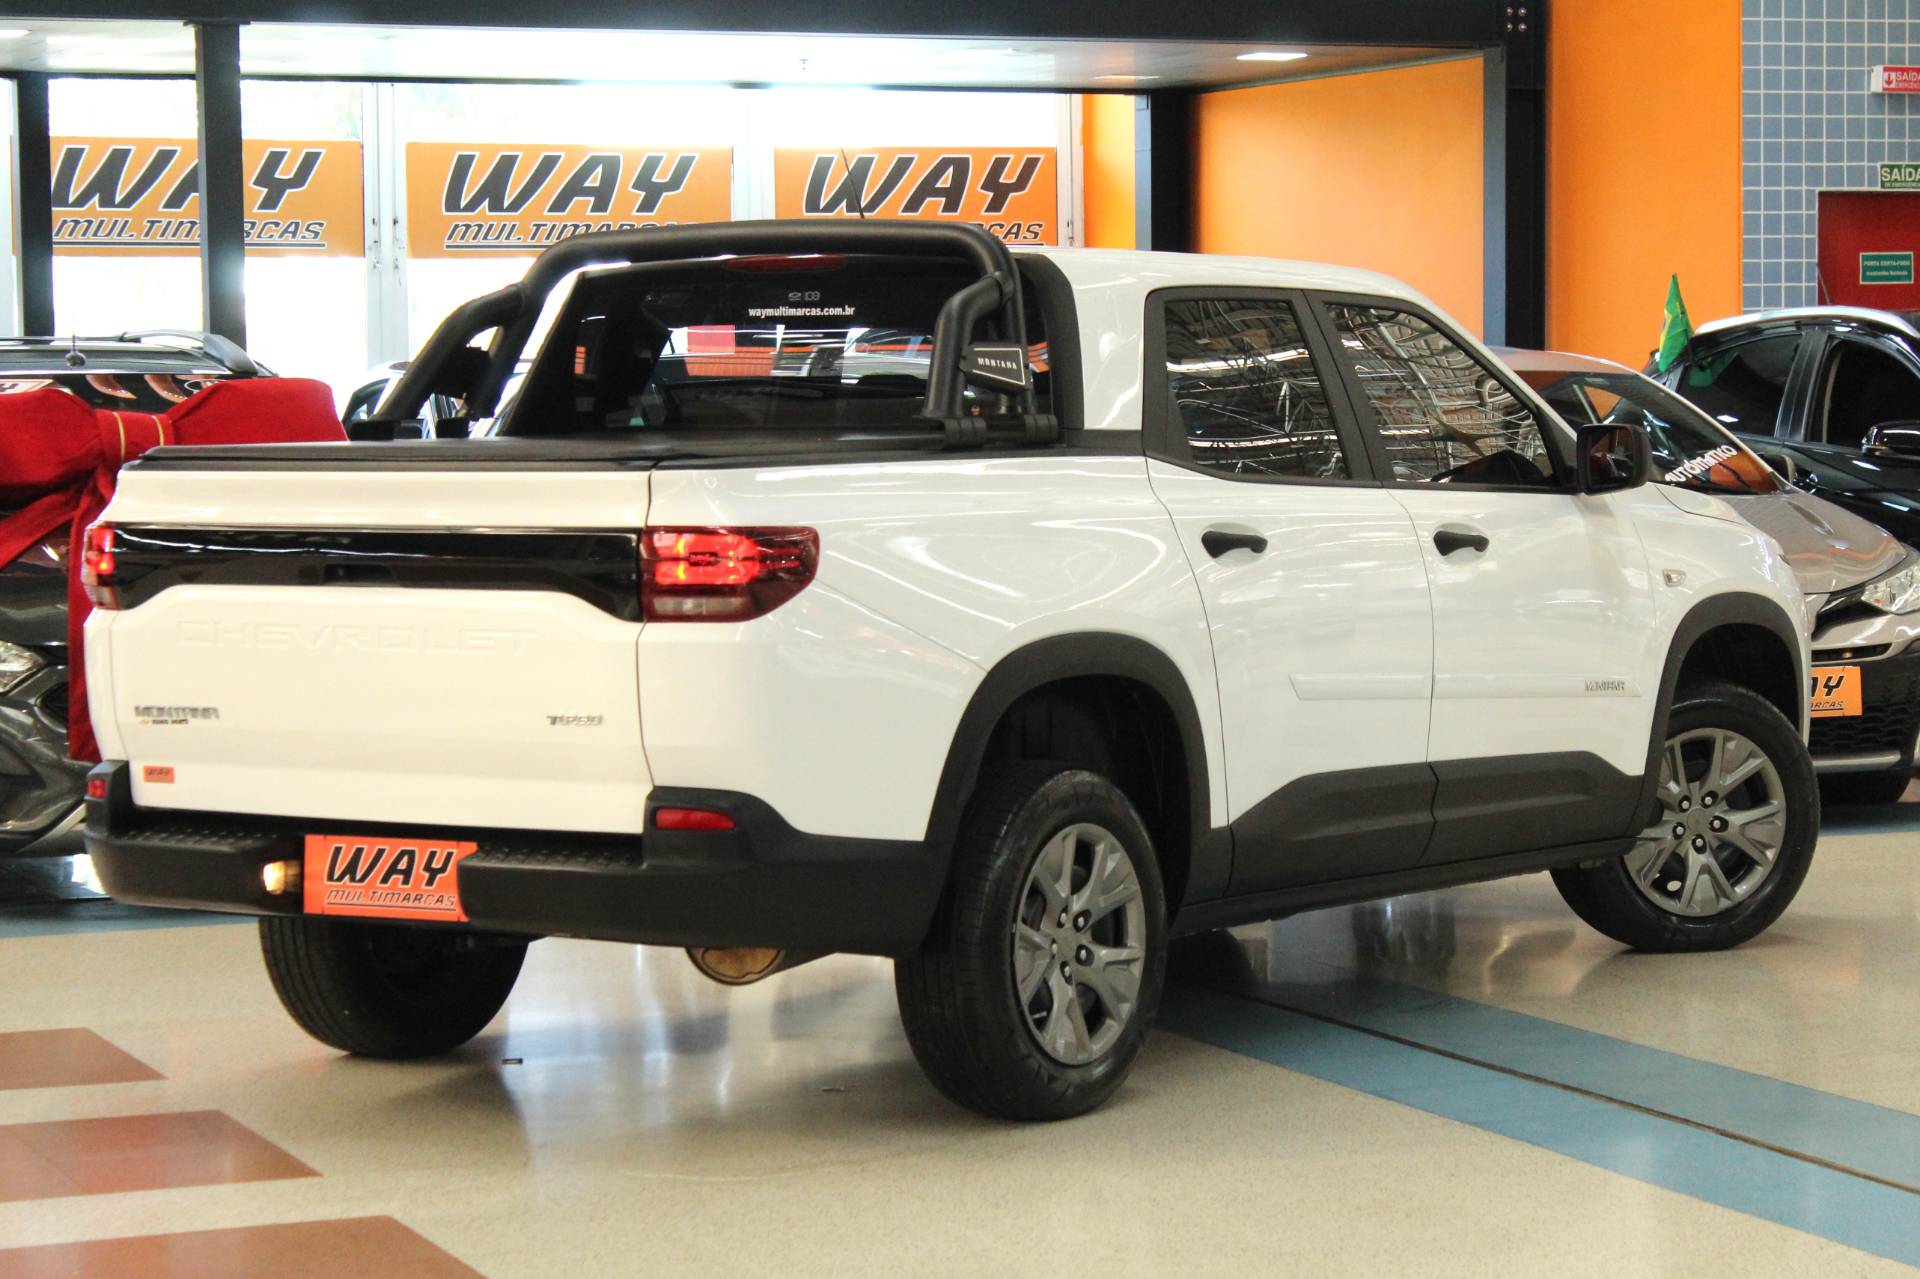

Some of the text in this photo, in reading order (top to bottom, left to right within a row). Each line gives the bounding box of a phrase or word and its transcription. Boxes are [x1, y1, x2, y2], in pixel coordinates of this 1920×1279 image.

[442, 152, 699, 215] WAY
[803, 154, 1045, 215] WAY
[748, 305, 855, 318] waymultimarcas.com.br
[977, 357, 1017, 370] MONTANA
[175, 620, 539, 656] CHEVROLET
[324, 844, 456, 889] WAY
[326, 889, 456, 907] MULTIMARCAS
